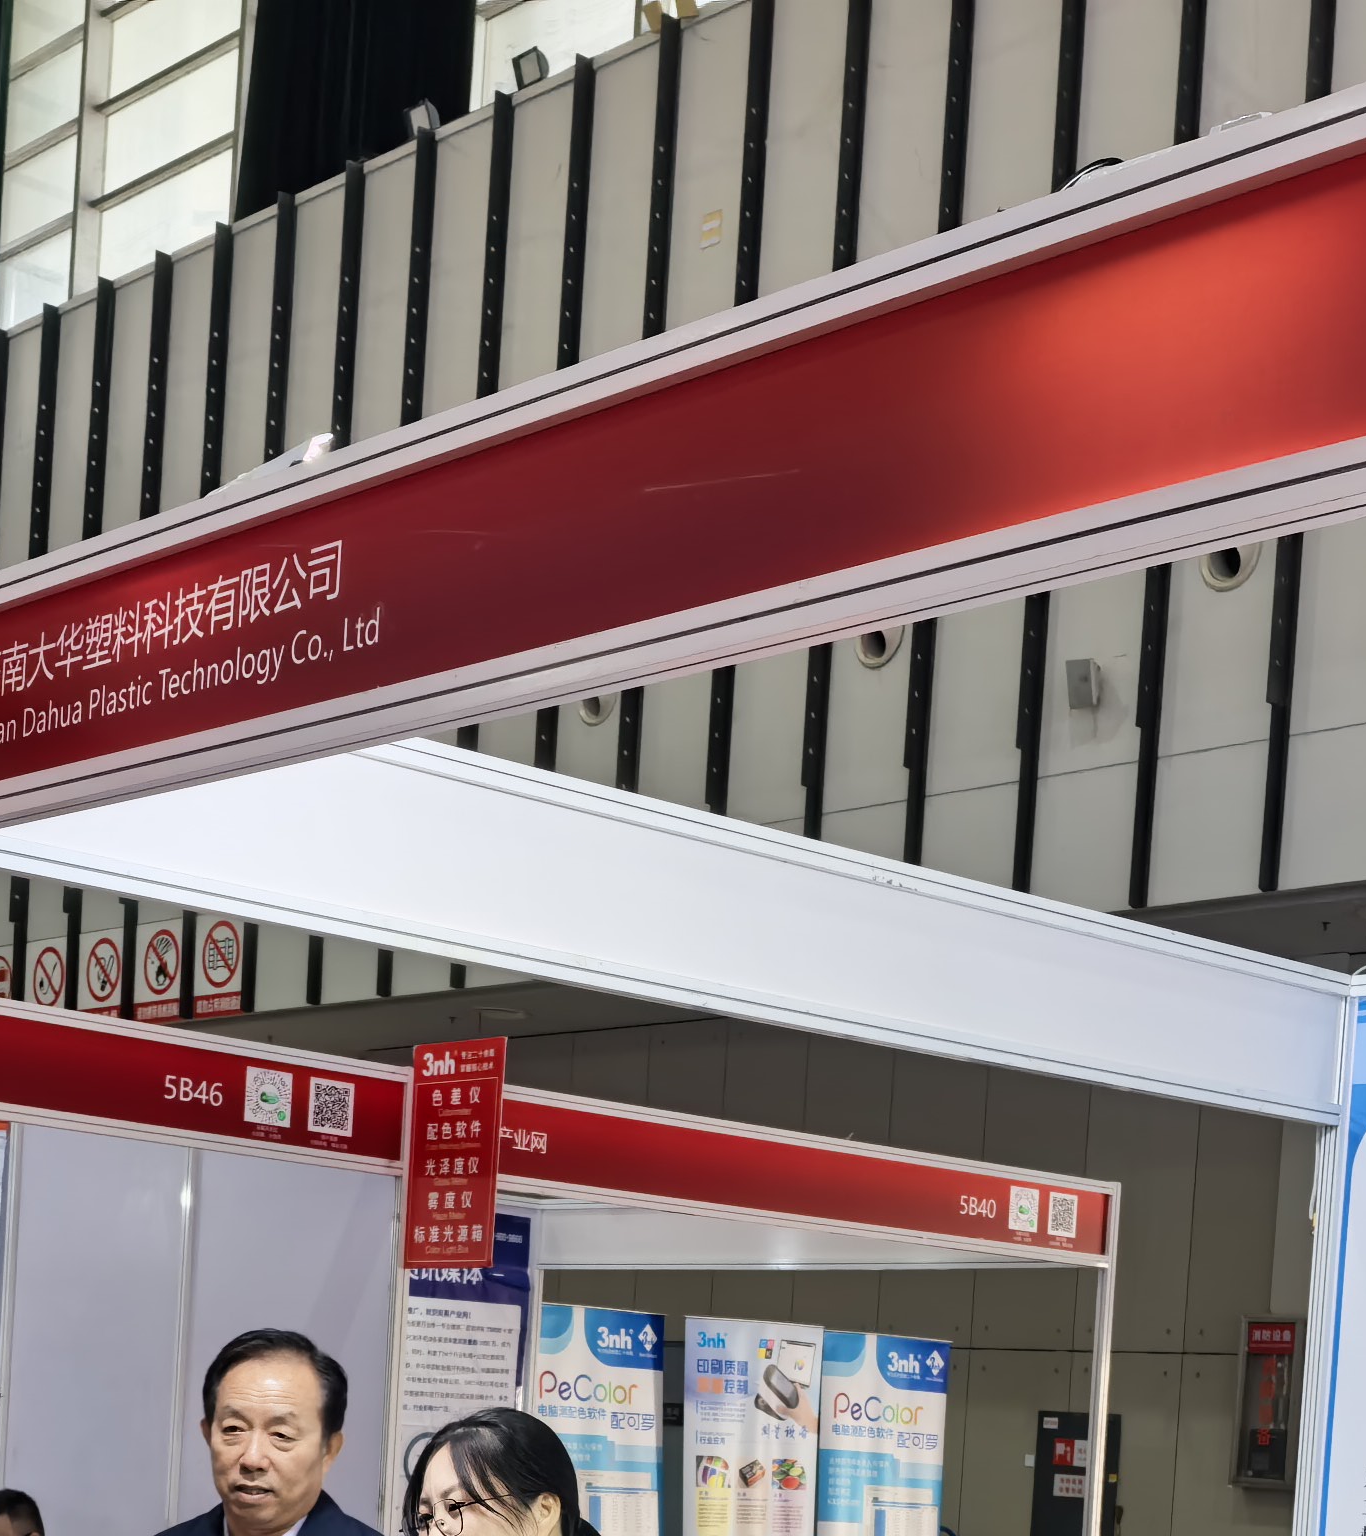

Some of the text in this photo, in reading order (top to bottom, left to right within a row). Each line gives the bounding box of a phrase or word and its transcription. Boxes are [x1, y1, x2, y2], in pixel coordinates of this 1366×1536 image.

[23, 698, 82, 737] Dahua
[89, 676, 152, 720] Plastic
[159, 637, 285, 701] Technology
[291, 627, 333, 664] Co.,
[342, 608, 380, 651] Ltd
[422, 1051, 455, 1077] 3nh
[164, 1074, 223, 1106] 5B46
[432, 1086, 481, 1107] 色差仪
[426, 1120, 482, 1141] 配色软件
[425, 1157, 480, 1177] 光泽度仪
[427, 1191, 473, 1210] 雾度仪
[959, 1195, 997, 1219] 5B40
[414, 1225, 483, 1244] 标准光源箱
[597, 1326, 633, 1350] 3nh
[696, 1331, 726, 1349] 3nh
[888, 1351, 920, 1375] 3nh
[538, 1370, 639, 1405] PeColor
[833, 1392, 924, 1426] PeColor
[610, 1411, 655, 1431] 配可罗
[897, 1432, 939, 1450] 配可罗
